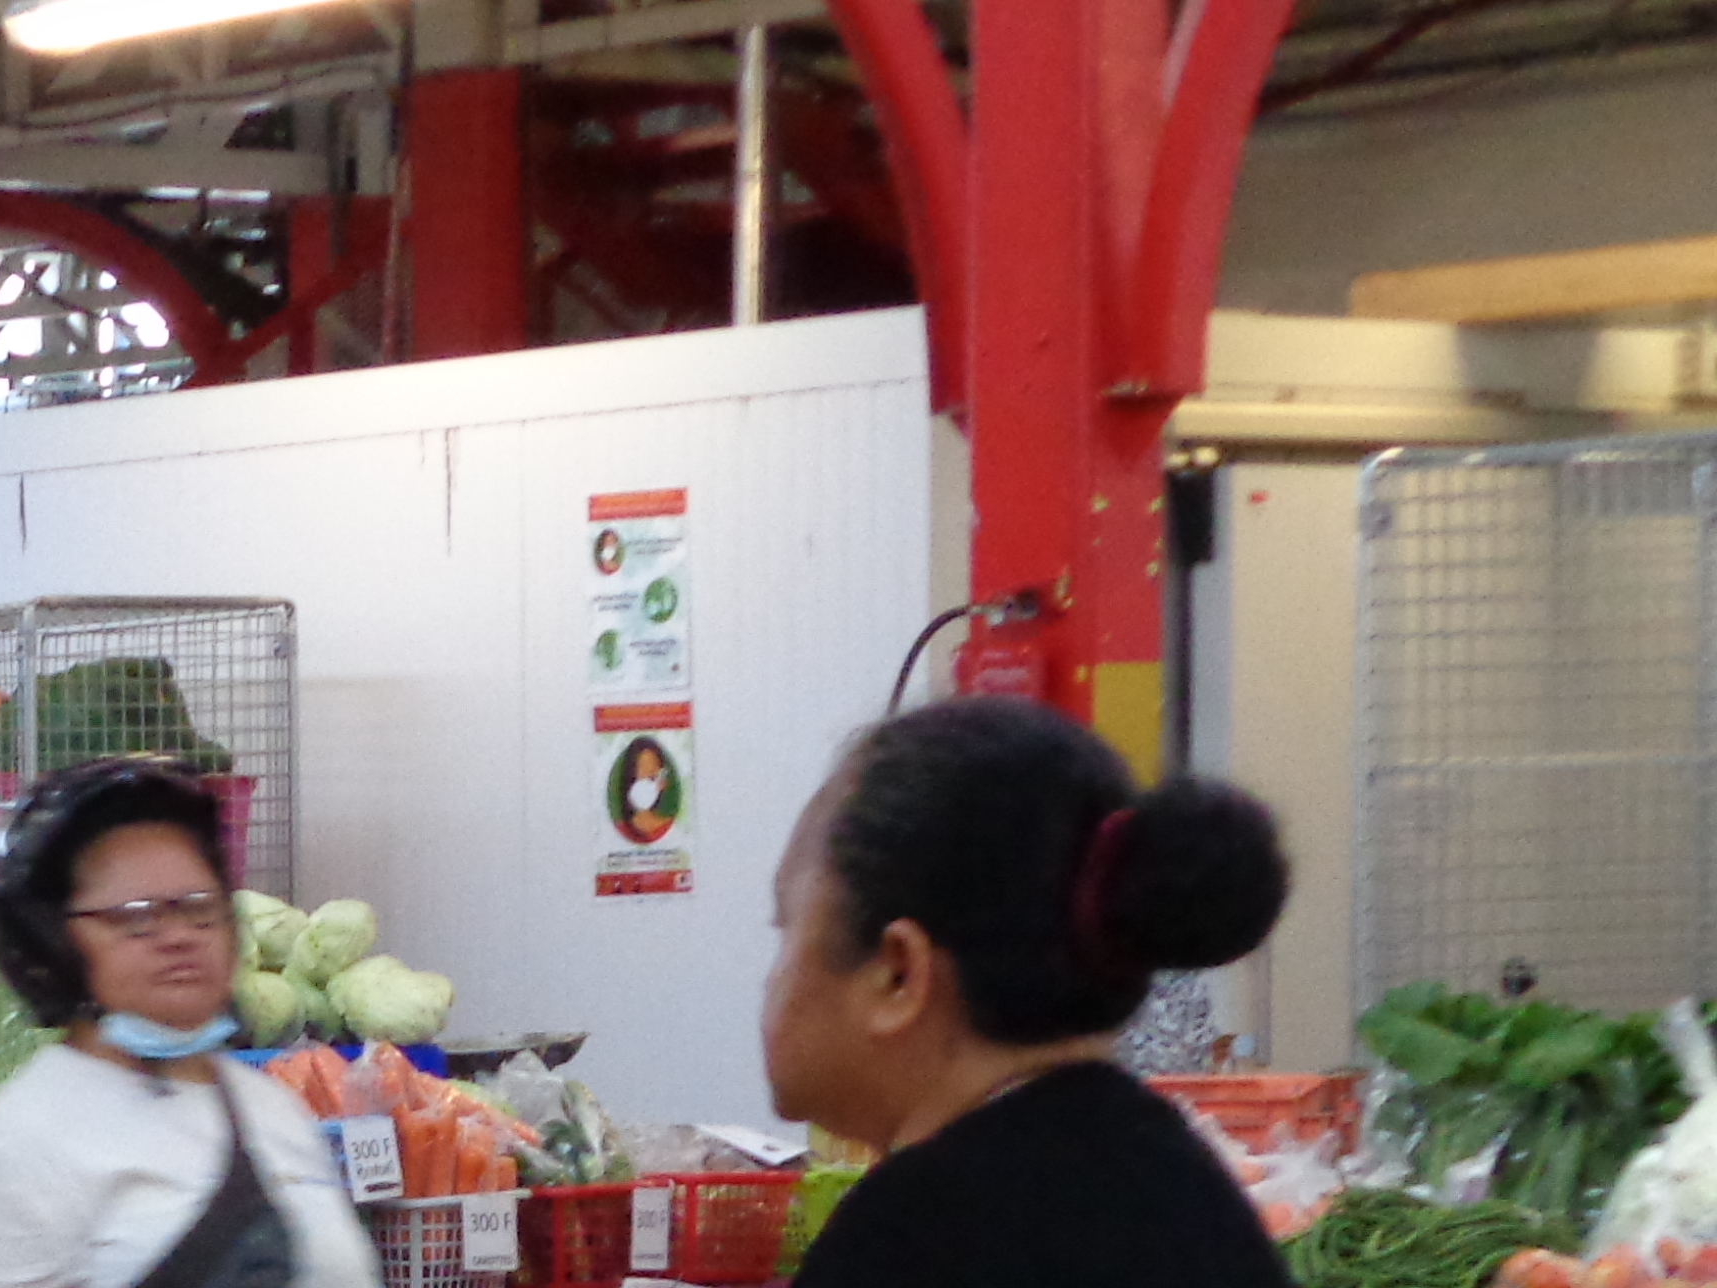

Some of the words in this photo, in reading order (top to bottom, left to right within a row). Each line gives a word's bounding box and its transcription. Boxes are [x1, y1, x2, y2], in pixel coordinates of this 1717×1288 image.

[351, 1139, 380, 1161] 300
[382, 1137, 391, 1155] F
[470, 1212, 499, 1232] 300
[503, 1212, 512, 1230] F
